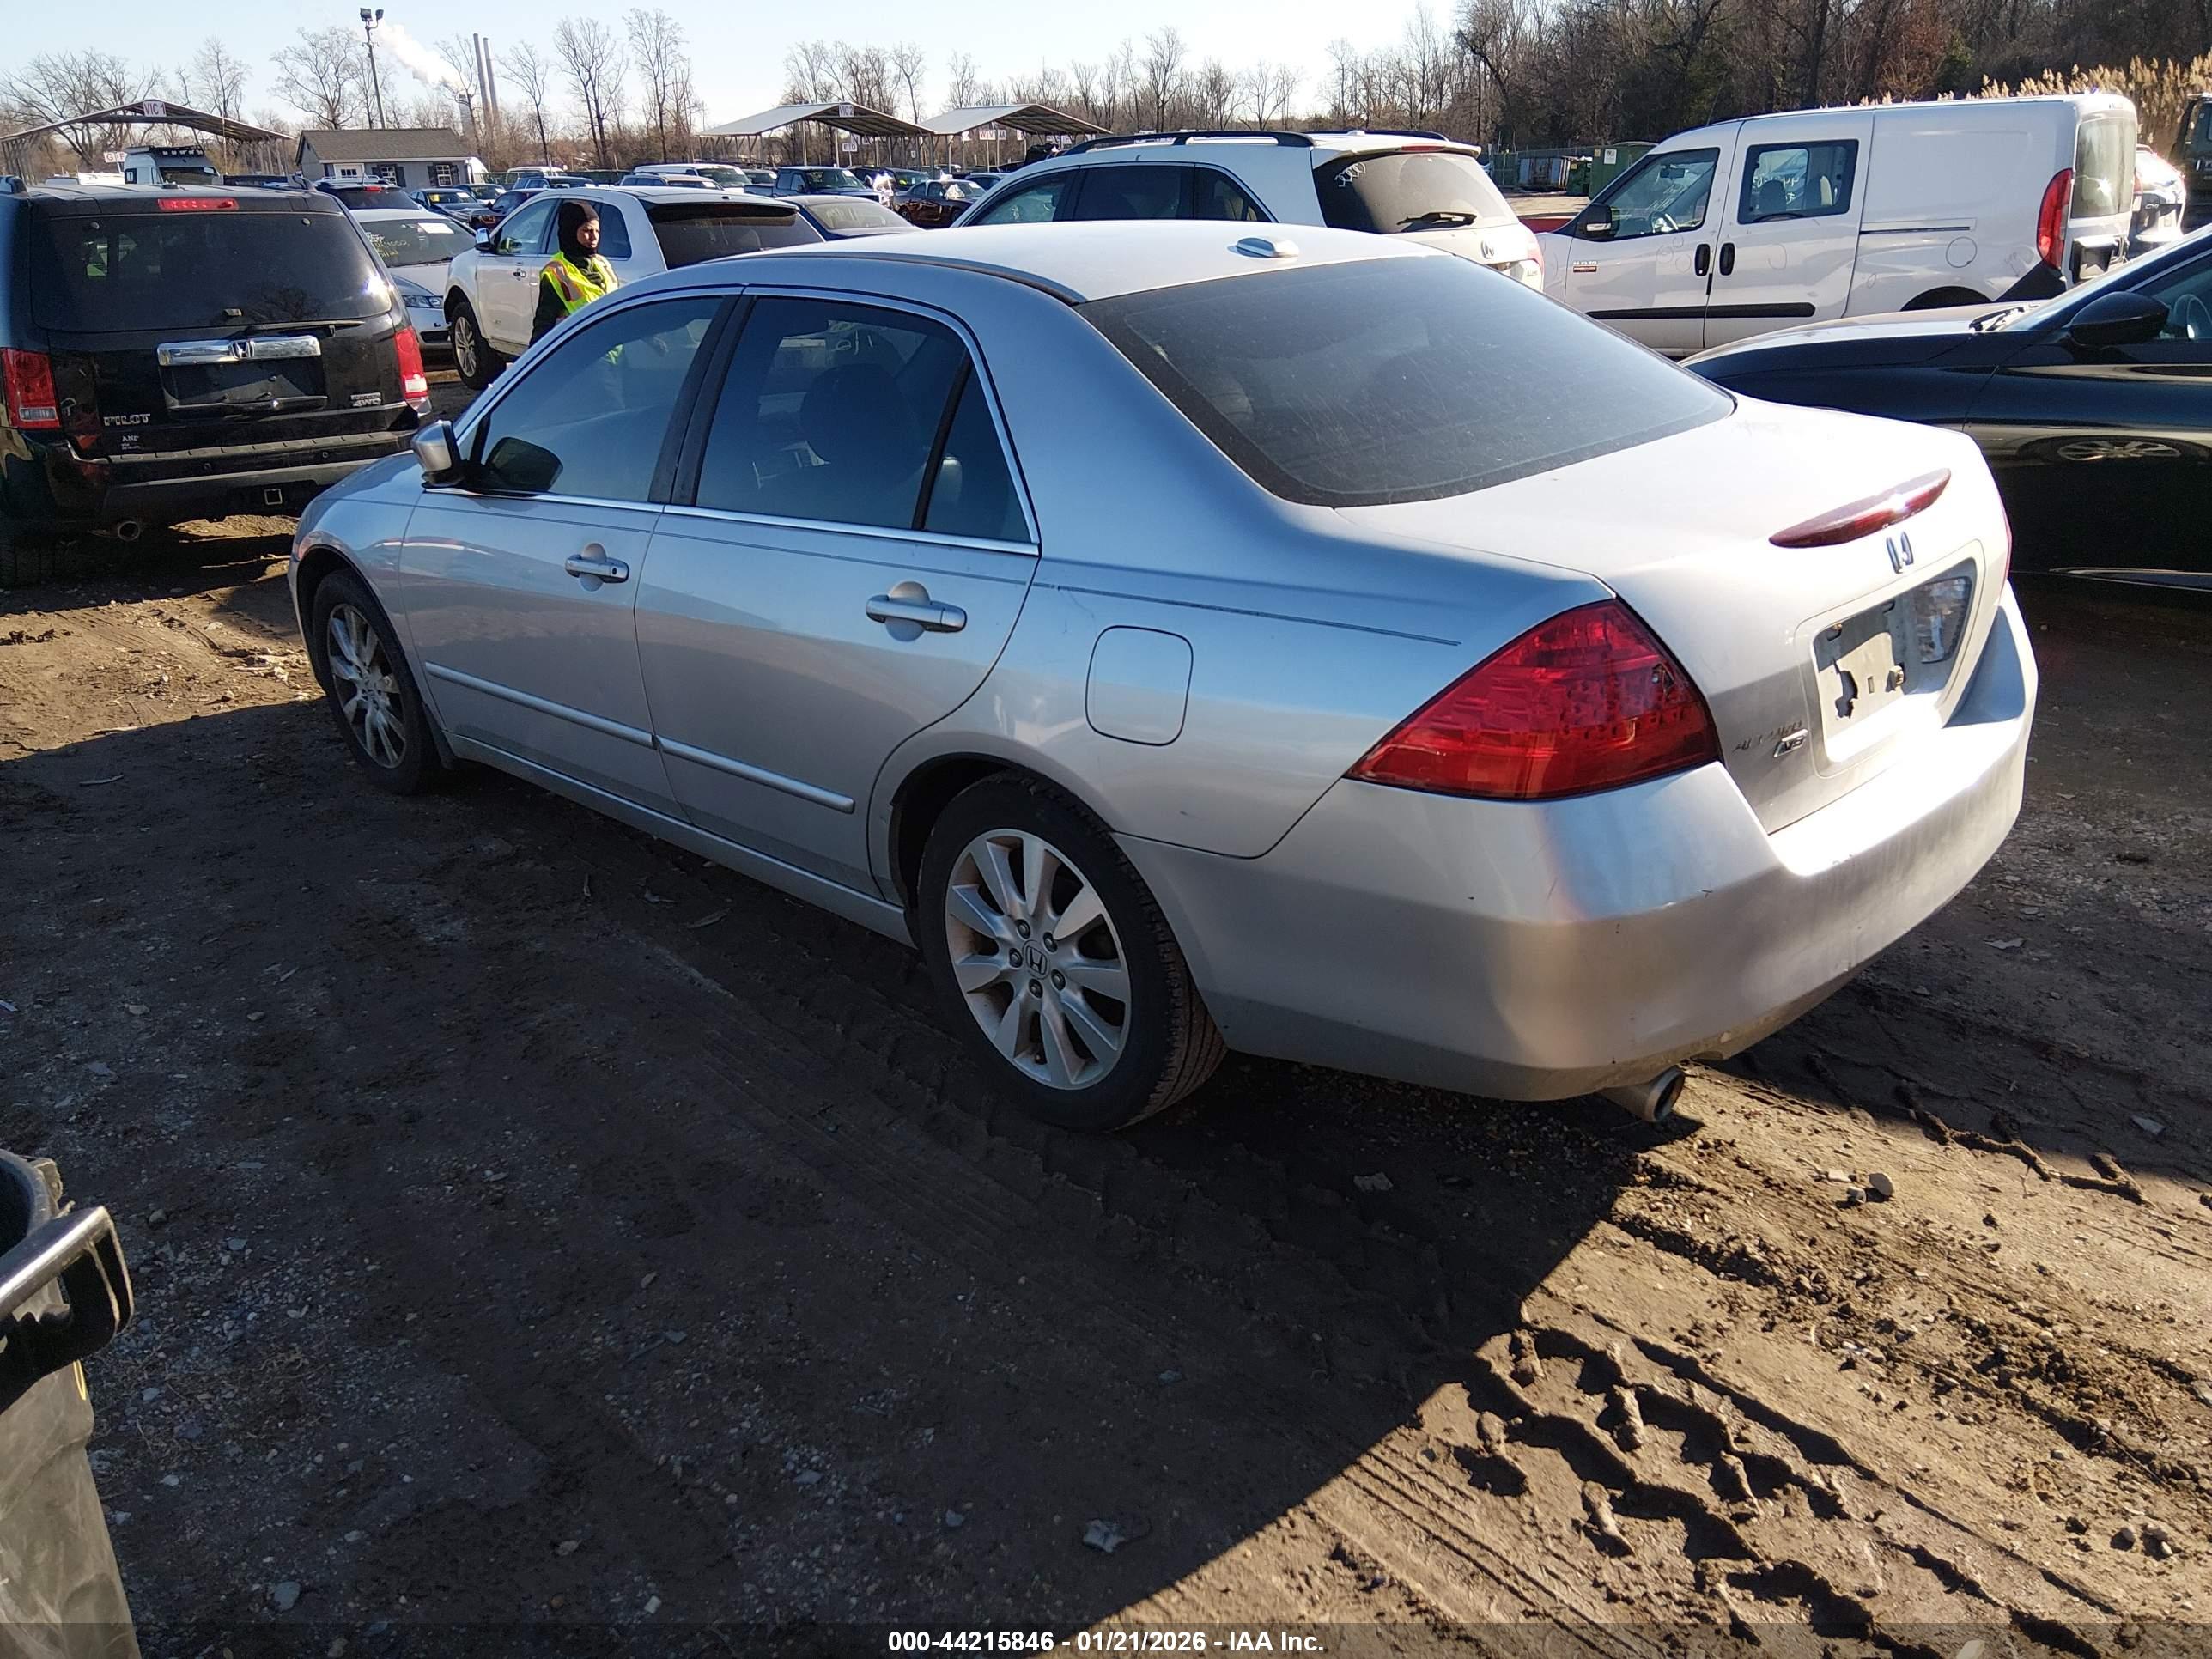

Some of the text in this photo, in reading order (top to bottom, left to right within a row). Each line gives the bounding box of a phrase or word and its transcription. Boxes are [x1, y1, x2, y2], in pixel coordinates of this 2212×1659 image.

[143, 103, 166, 115] VIC 1
[103, 413, 151, 427] PILOT
